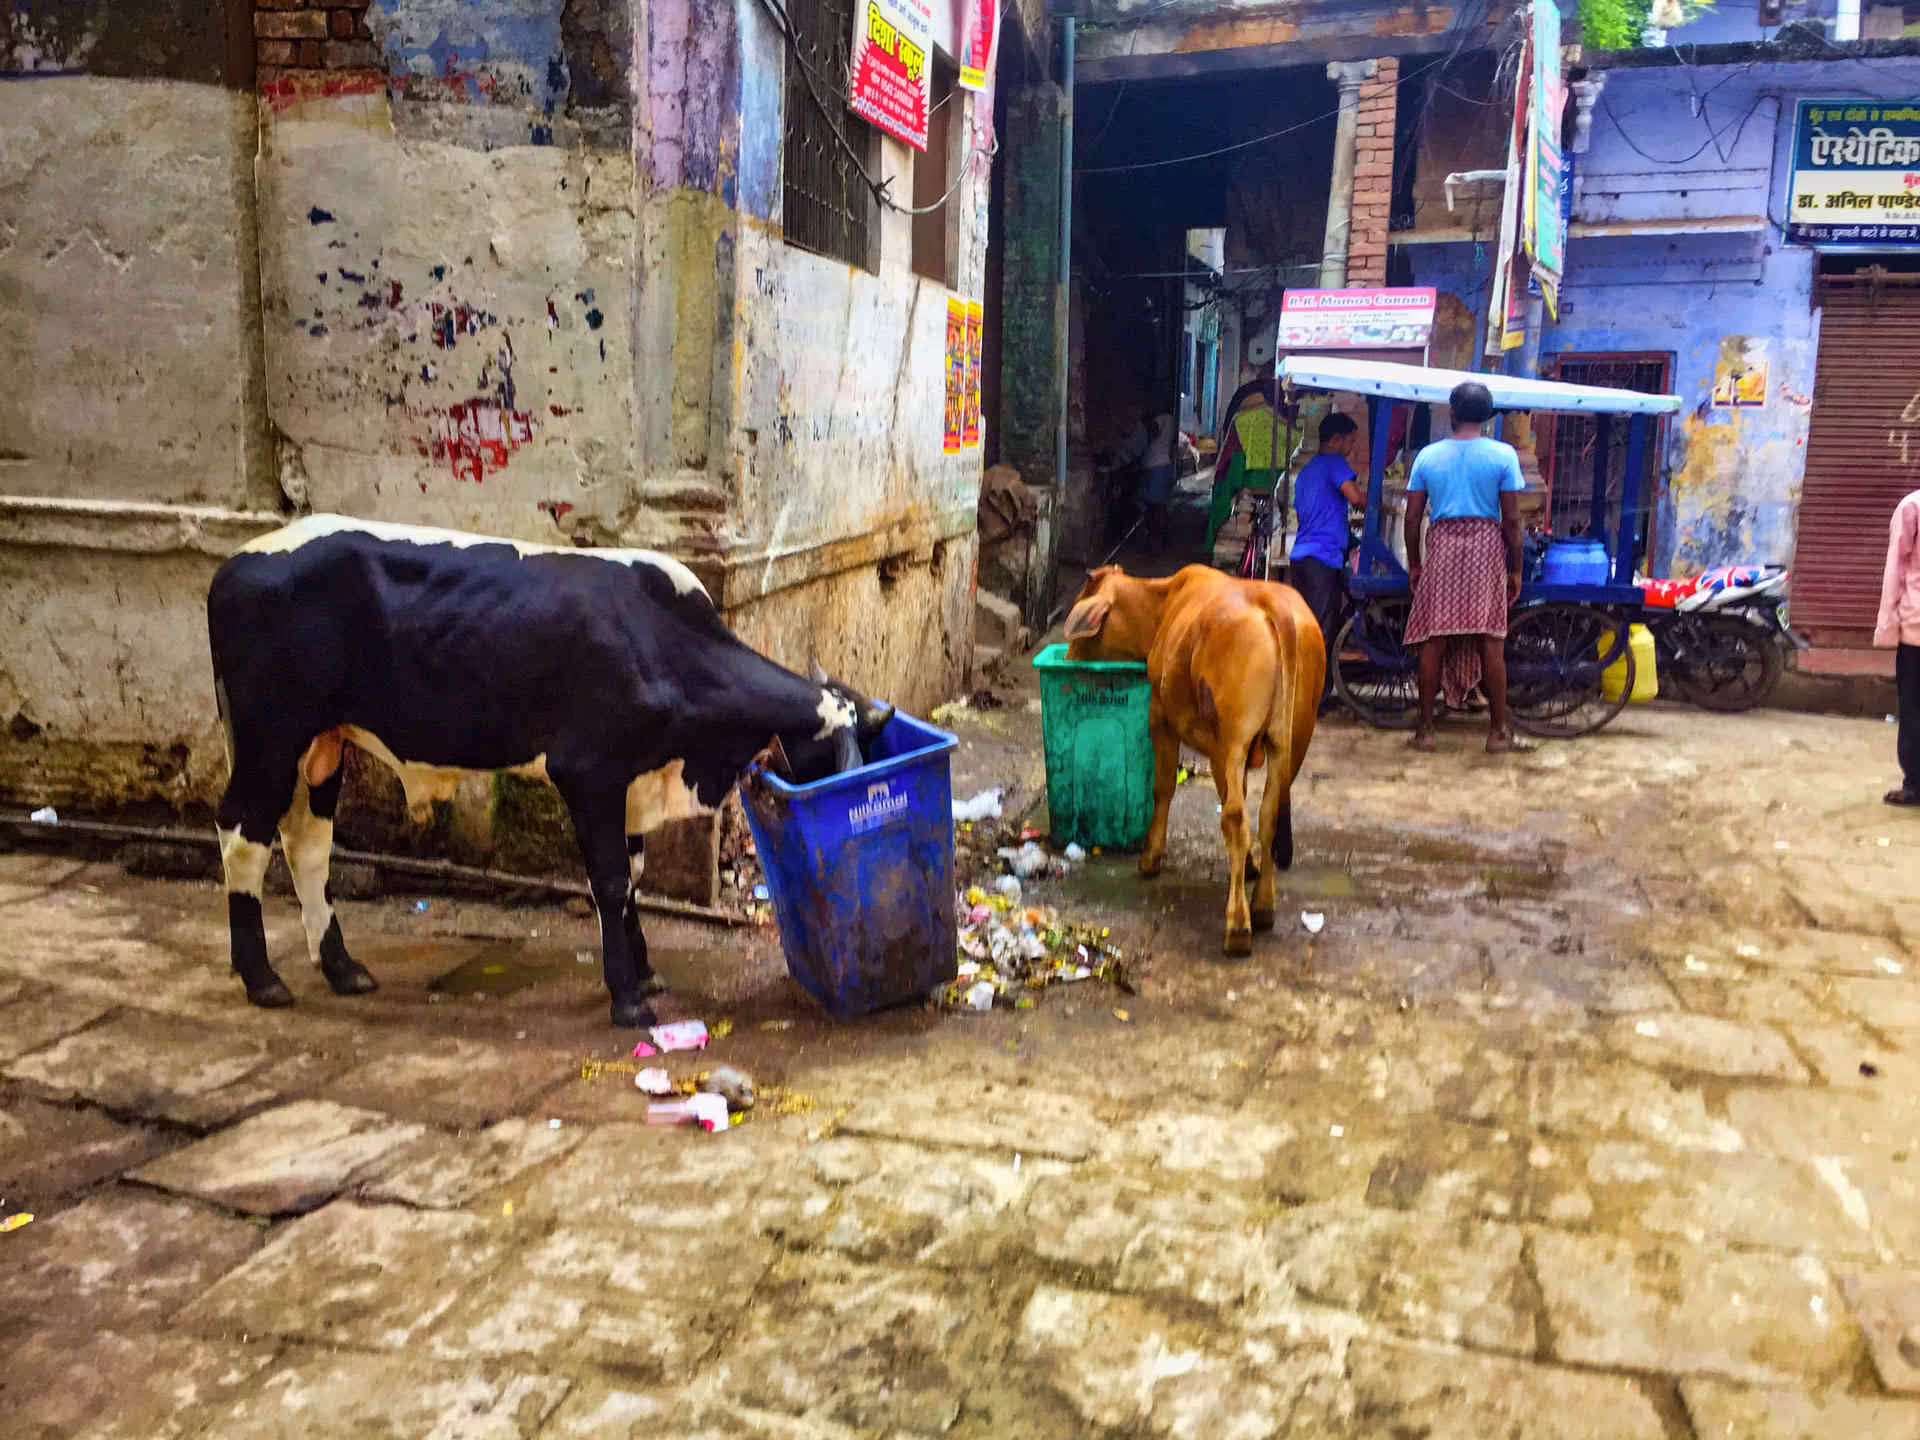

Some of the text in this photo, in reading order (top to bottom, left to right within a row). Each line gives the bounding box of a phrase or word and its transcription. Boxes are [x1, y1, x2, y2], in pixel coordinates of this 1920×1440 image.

[867, 1, 897, 56] दिशा
[898, 31, 925, 82] स्कूल
[1825, 191, 1873, 208] अनिल
